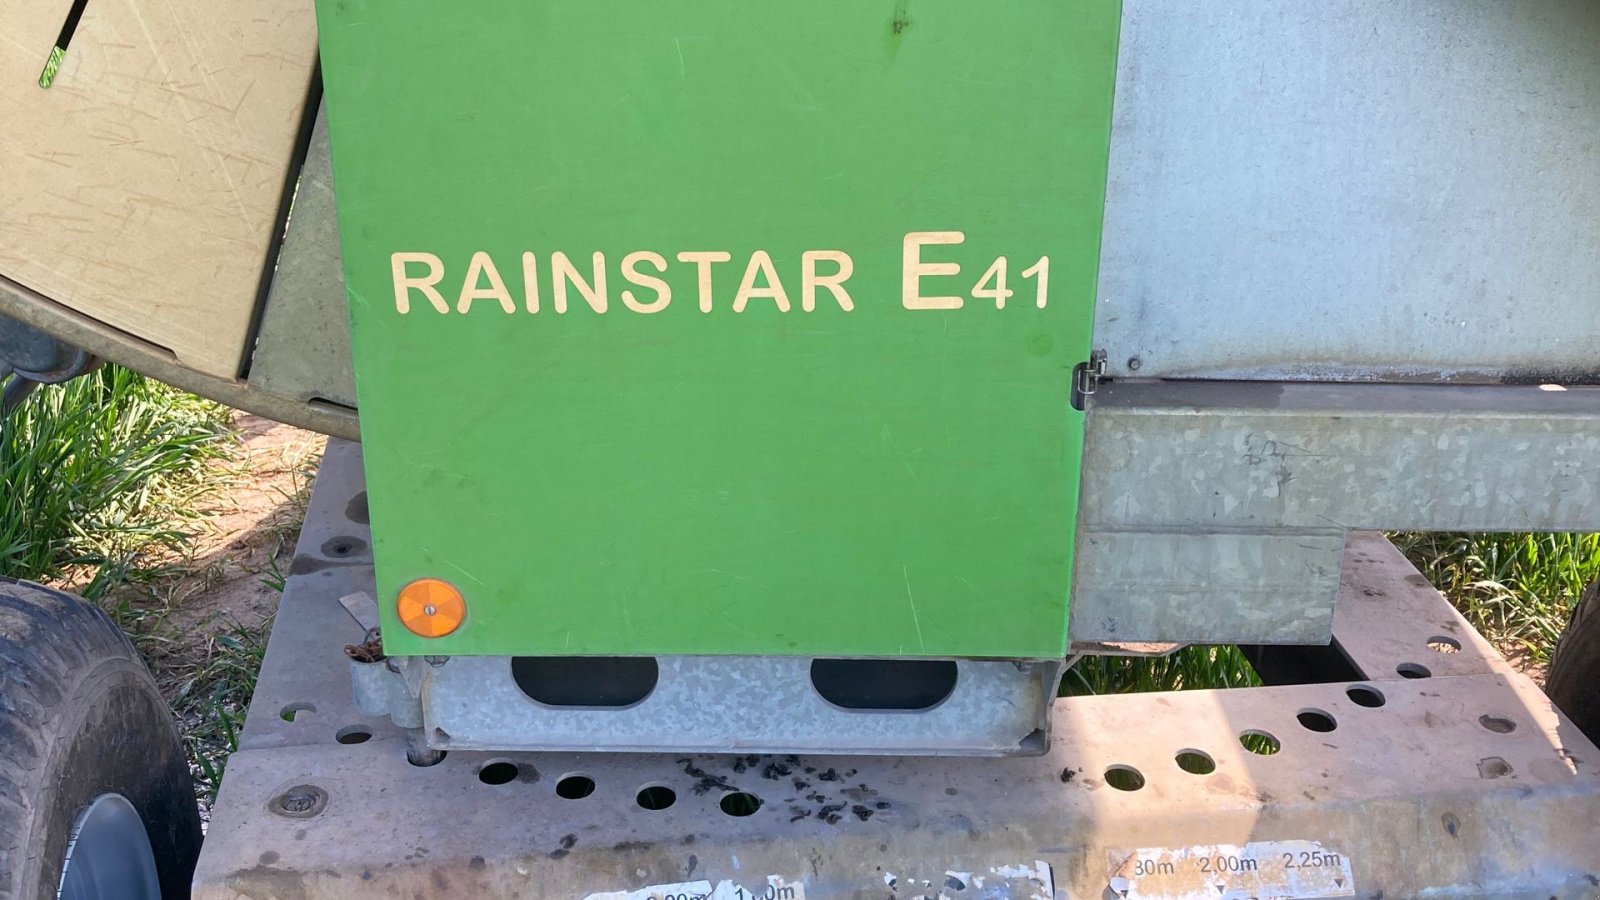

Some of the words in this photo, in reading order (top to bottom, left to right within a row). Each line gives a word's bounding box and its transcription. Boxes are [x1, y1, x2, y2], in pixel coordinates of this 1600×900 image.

[391, 250, 855, 314] RAINSTAR
[902, 230, 1050, 310] E41
[1200, 855, 1258, 875] 2,00m
[1283, 851, 1341, 872] 2,25m
